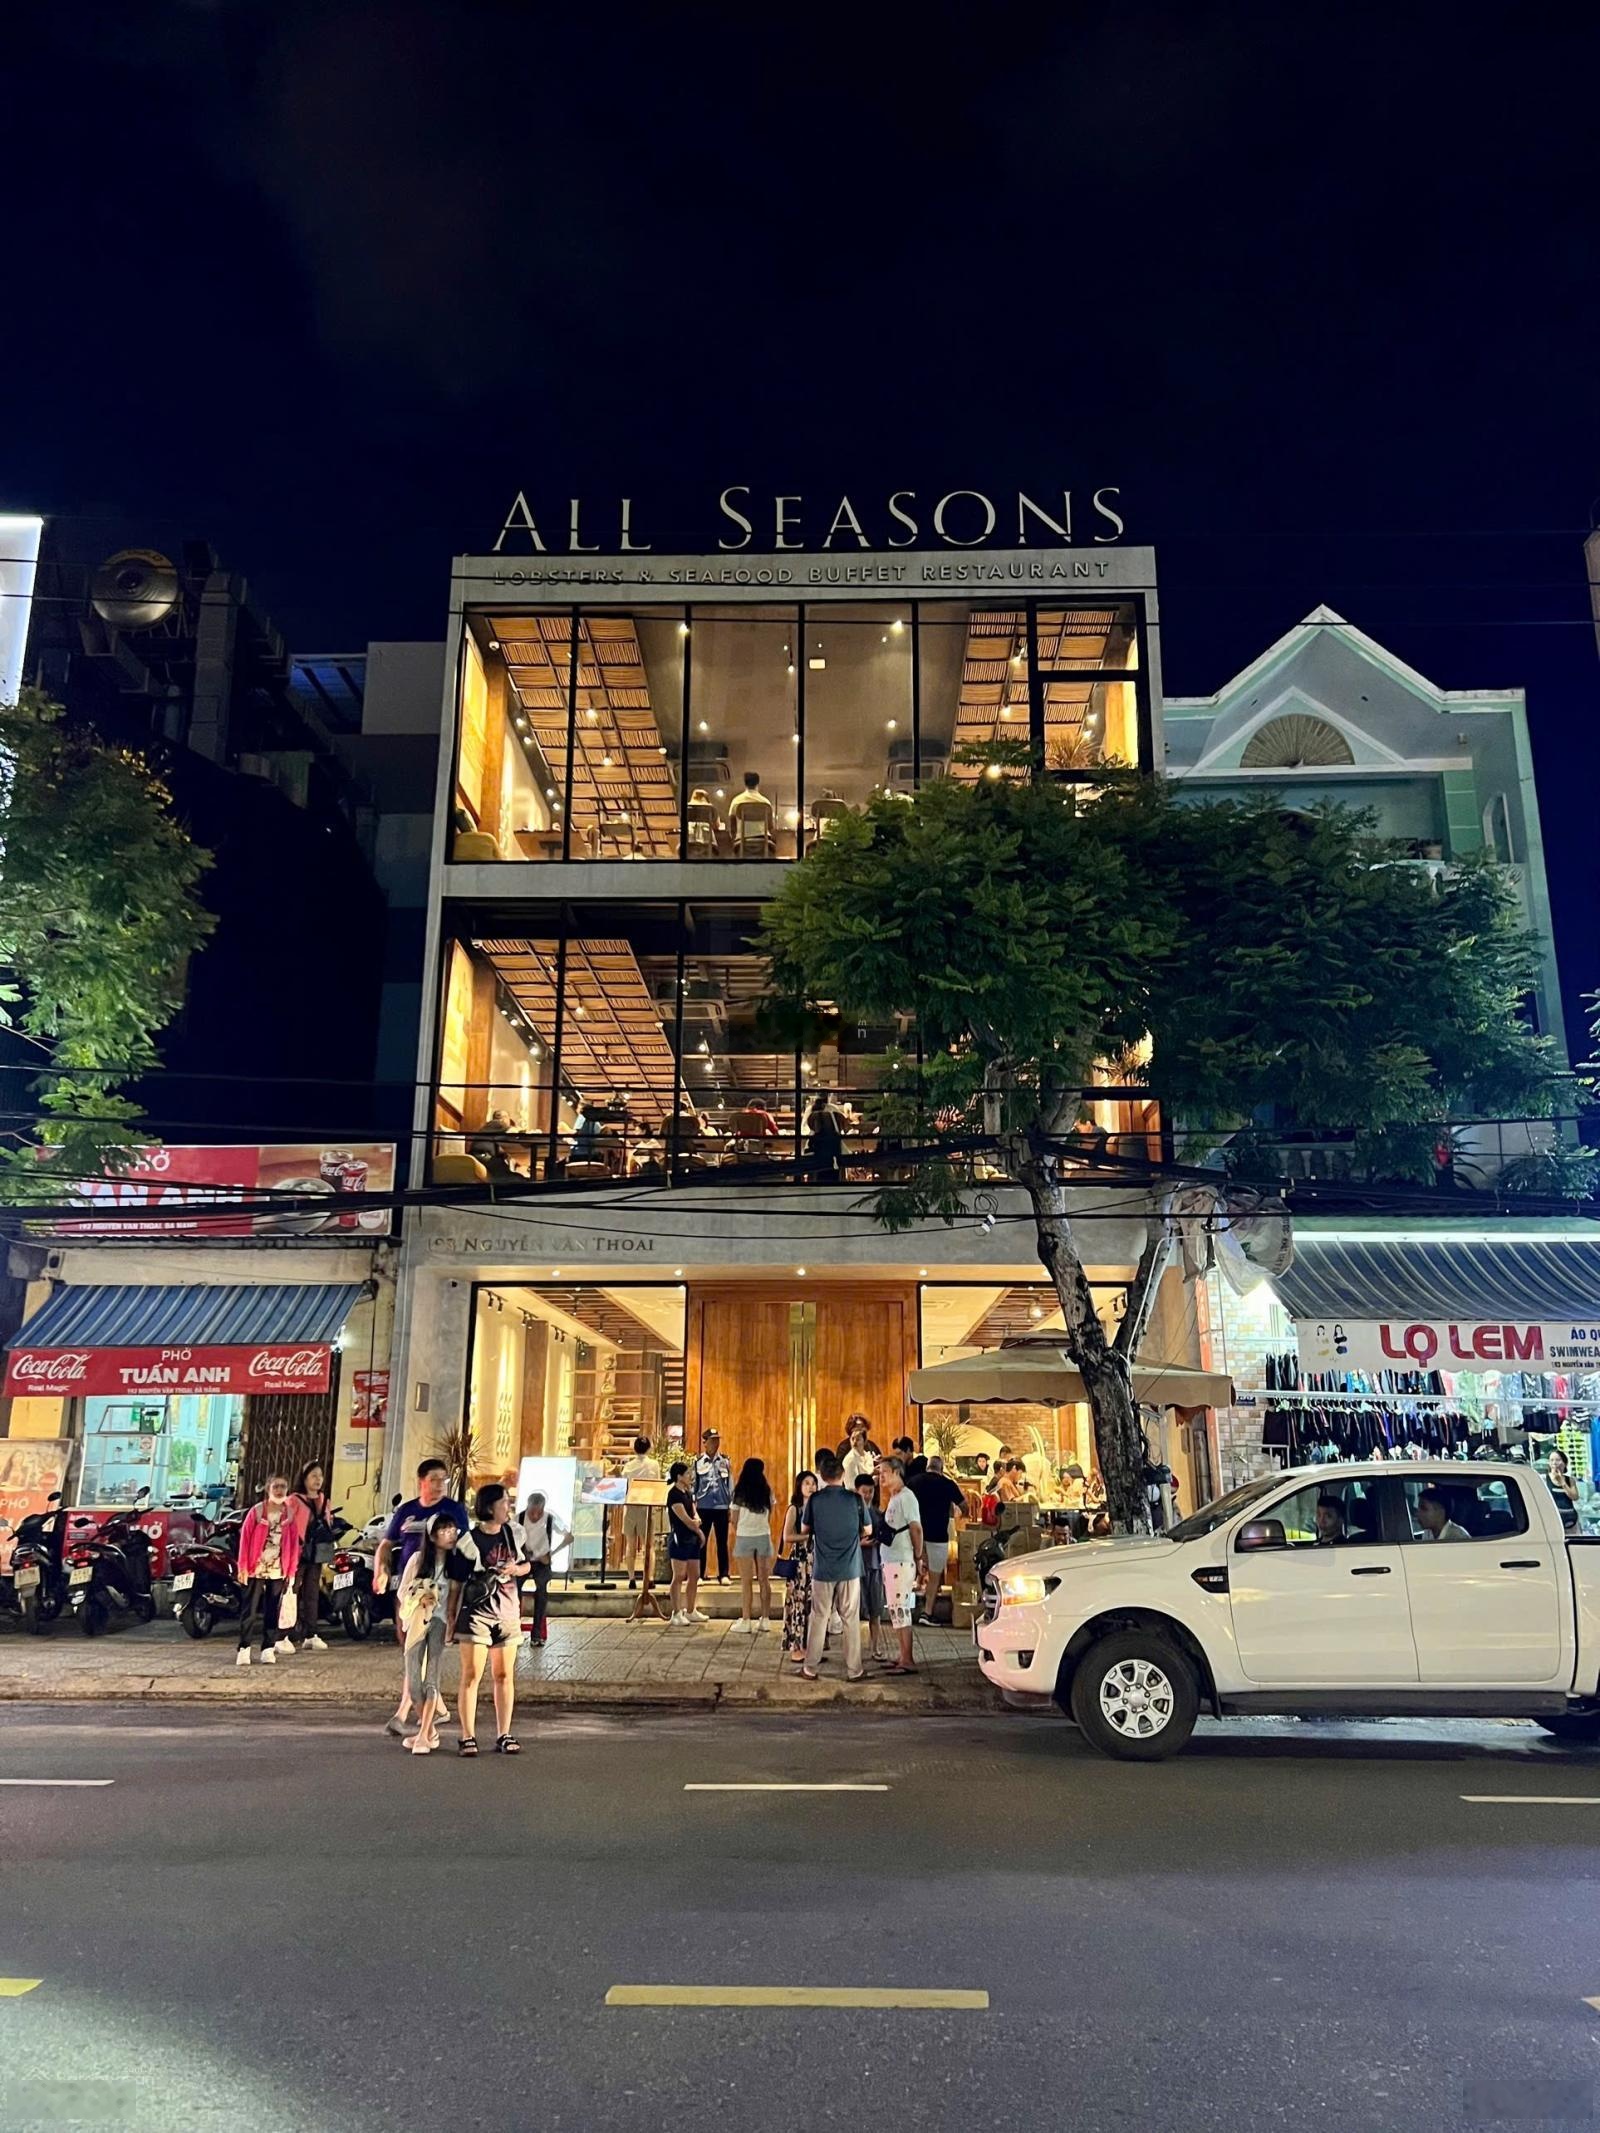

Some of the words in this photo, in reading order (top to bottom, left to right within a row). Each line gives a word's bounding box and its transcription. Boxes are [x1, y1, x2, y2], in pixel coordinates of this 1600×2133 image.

[492, 490, 652, 551] ALL
[718, 486, 1124, 549] SEASONS
[493, 568, 623, 585] LOBSTERS
[639, 570, 653, 584] &
[670, 567, 793, 584] SEAFOOD
[809, 566, 906, 583] BUFFET
[922, 561, 1109, 582] RESTAURANT
[1448, 1325, 1545, 1360] LEM
[12, 1353, 93, 1380] Coca-Cola
[119, 1363, 179, 1384] TUẤN
[183, 1366, 231, 1383] ANH
[248, 1347, 328, 1377] Coca-Cola
